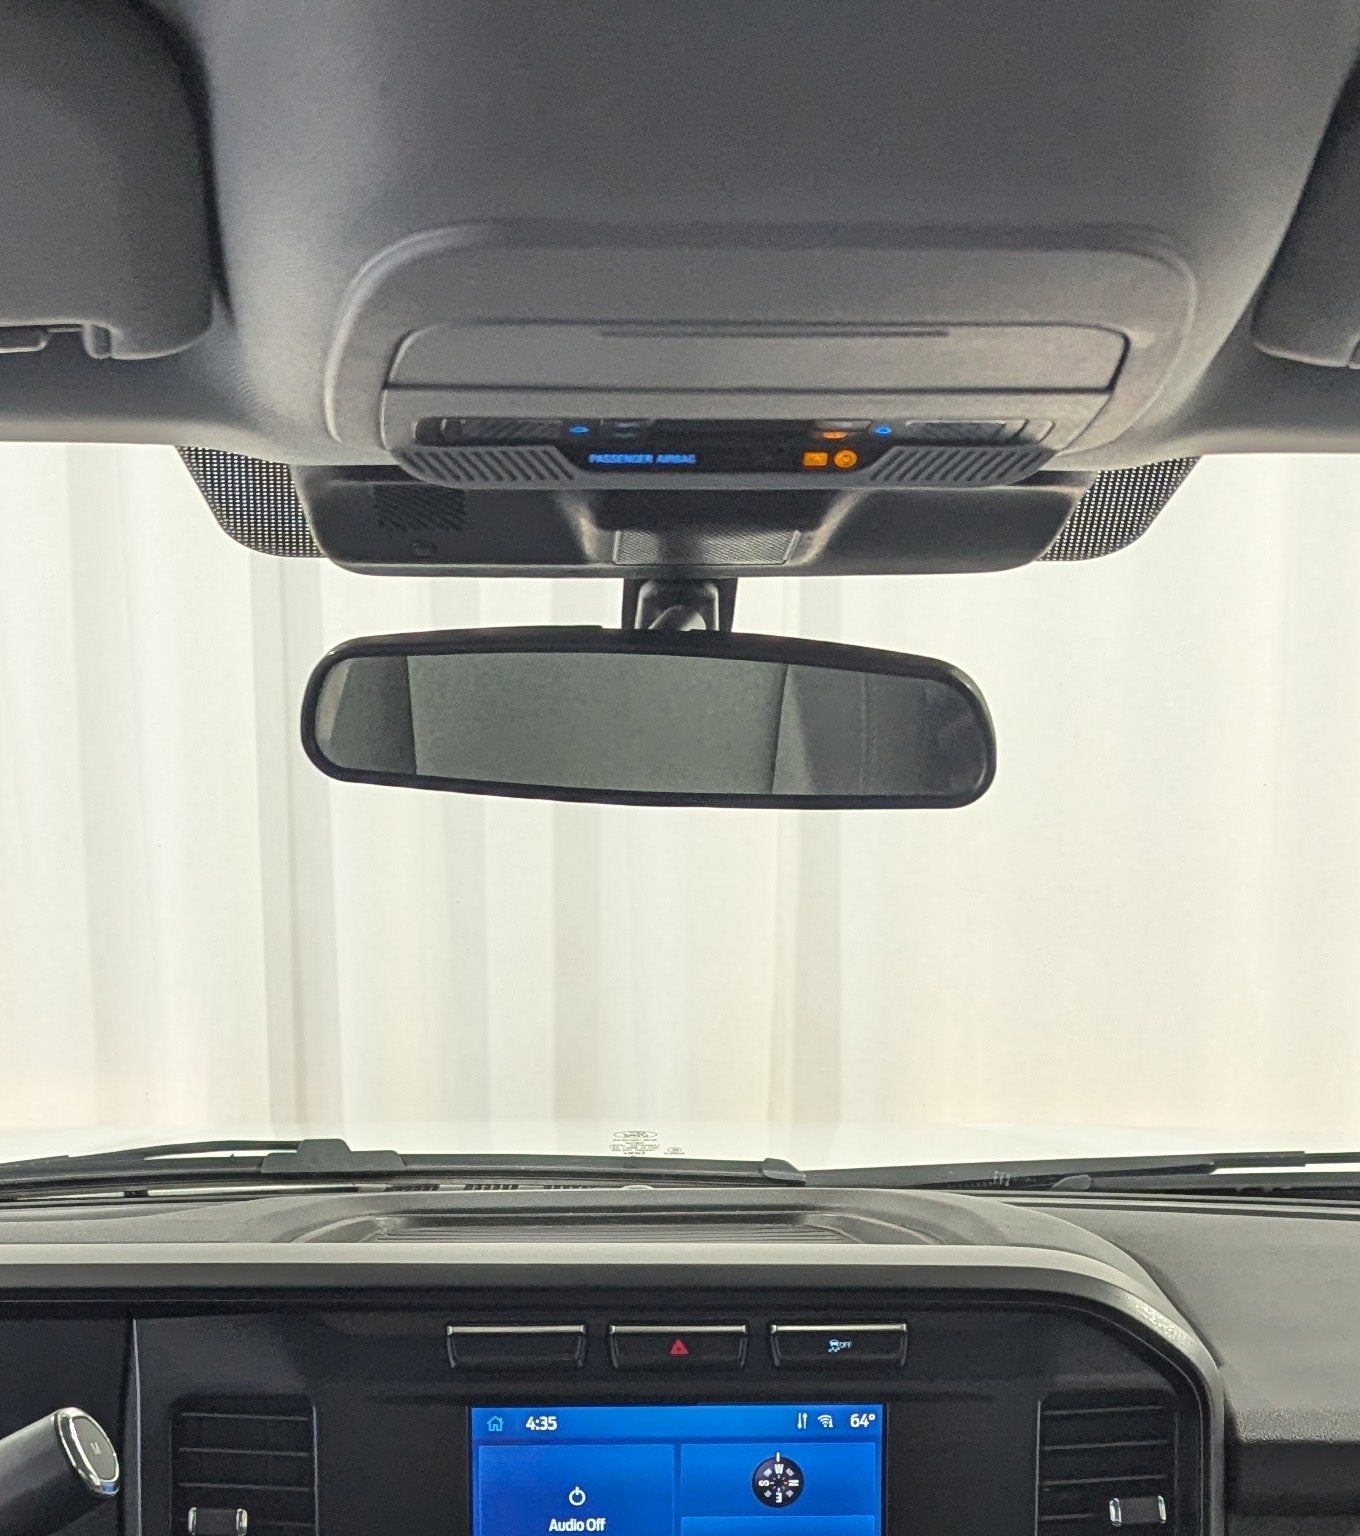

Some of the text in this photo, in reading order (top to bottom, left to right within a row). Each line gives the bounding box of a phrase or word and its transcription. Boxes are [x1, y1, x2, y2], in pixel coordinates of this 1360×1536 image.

[588, 453, 697, 465] PASSENGER AIRBAG
[525, 1415, 558, 1431] 4:35
[774, 1463, 784, 1475] W
[549, 1517, 606, 1533] Audio Off
